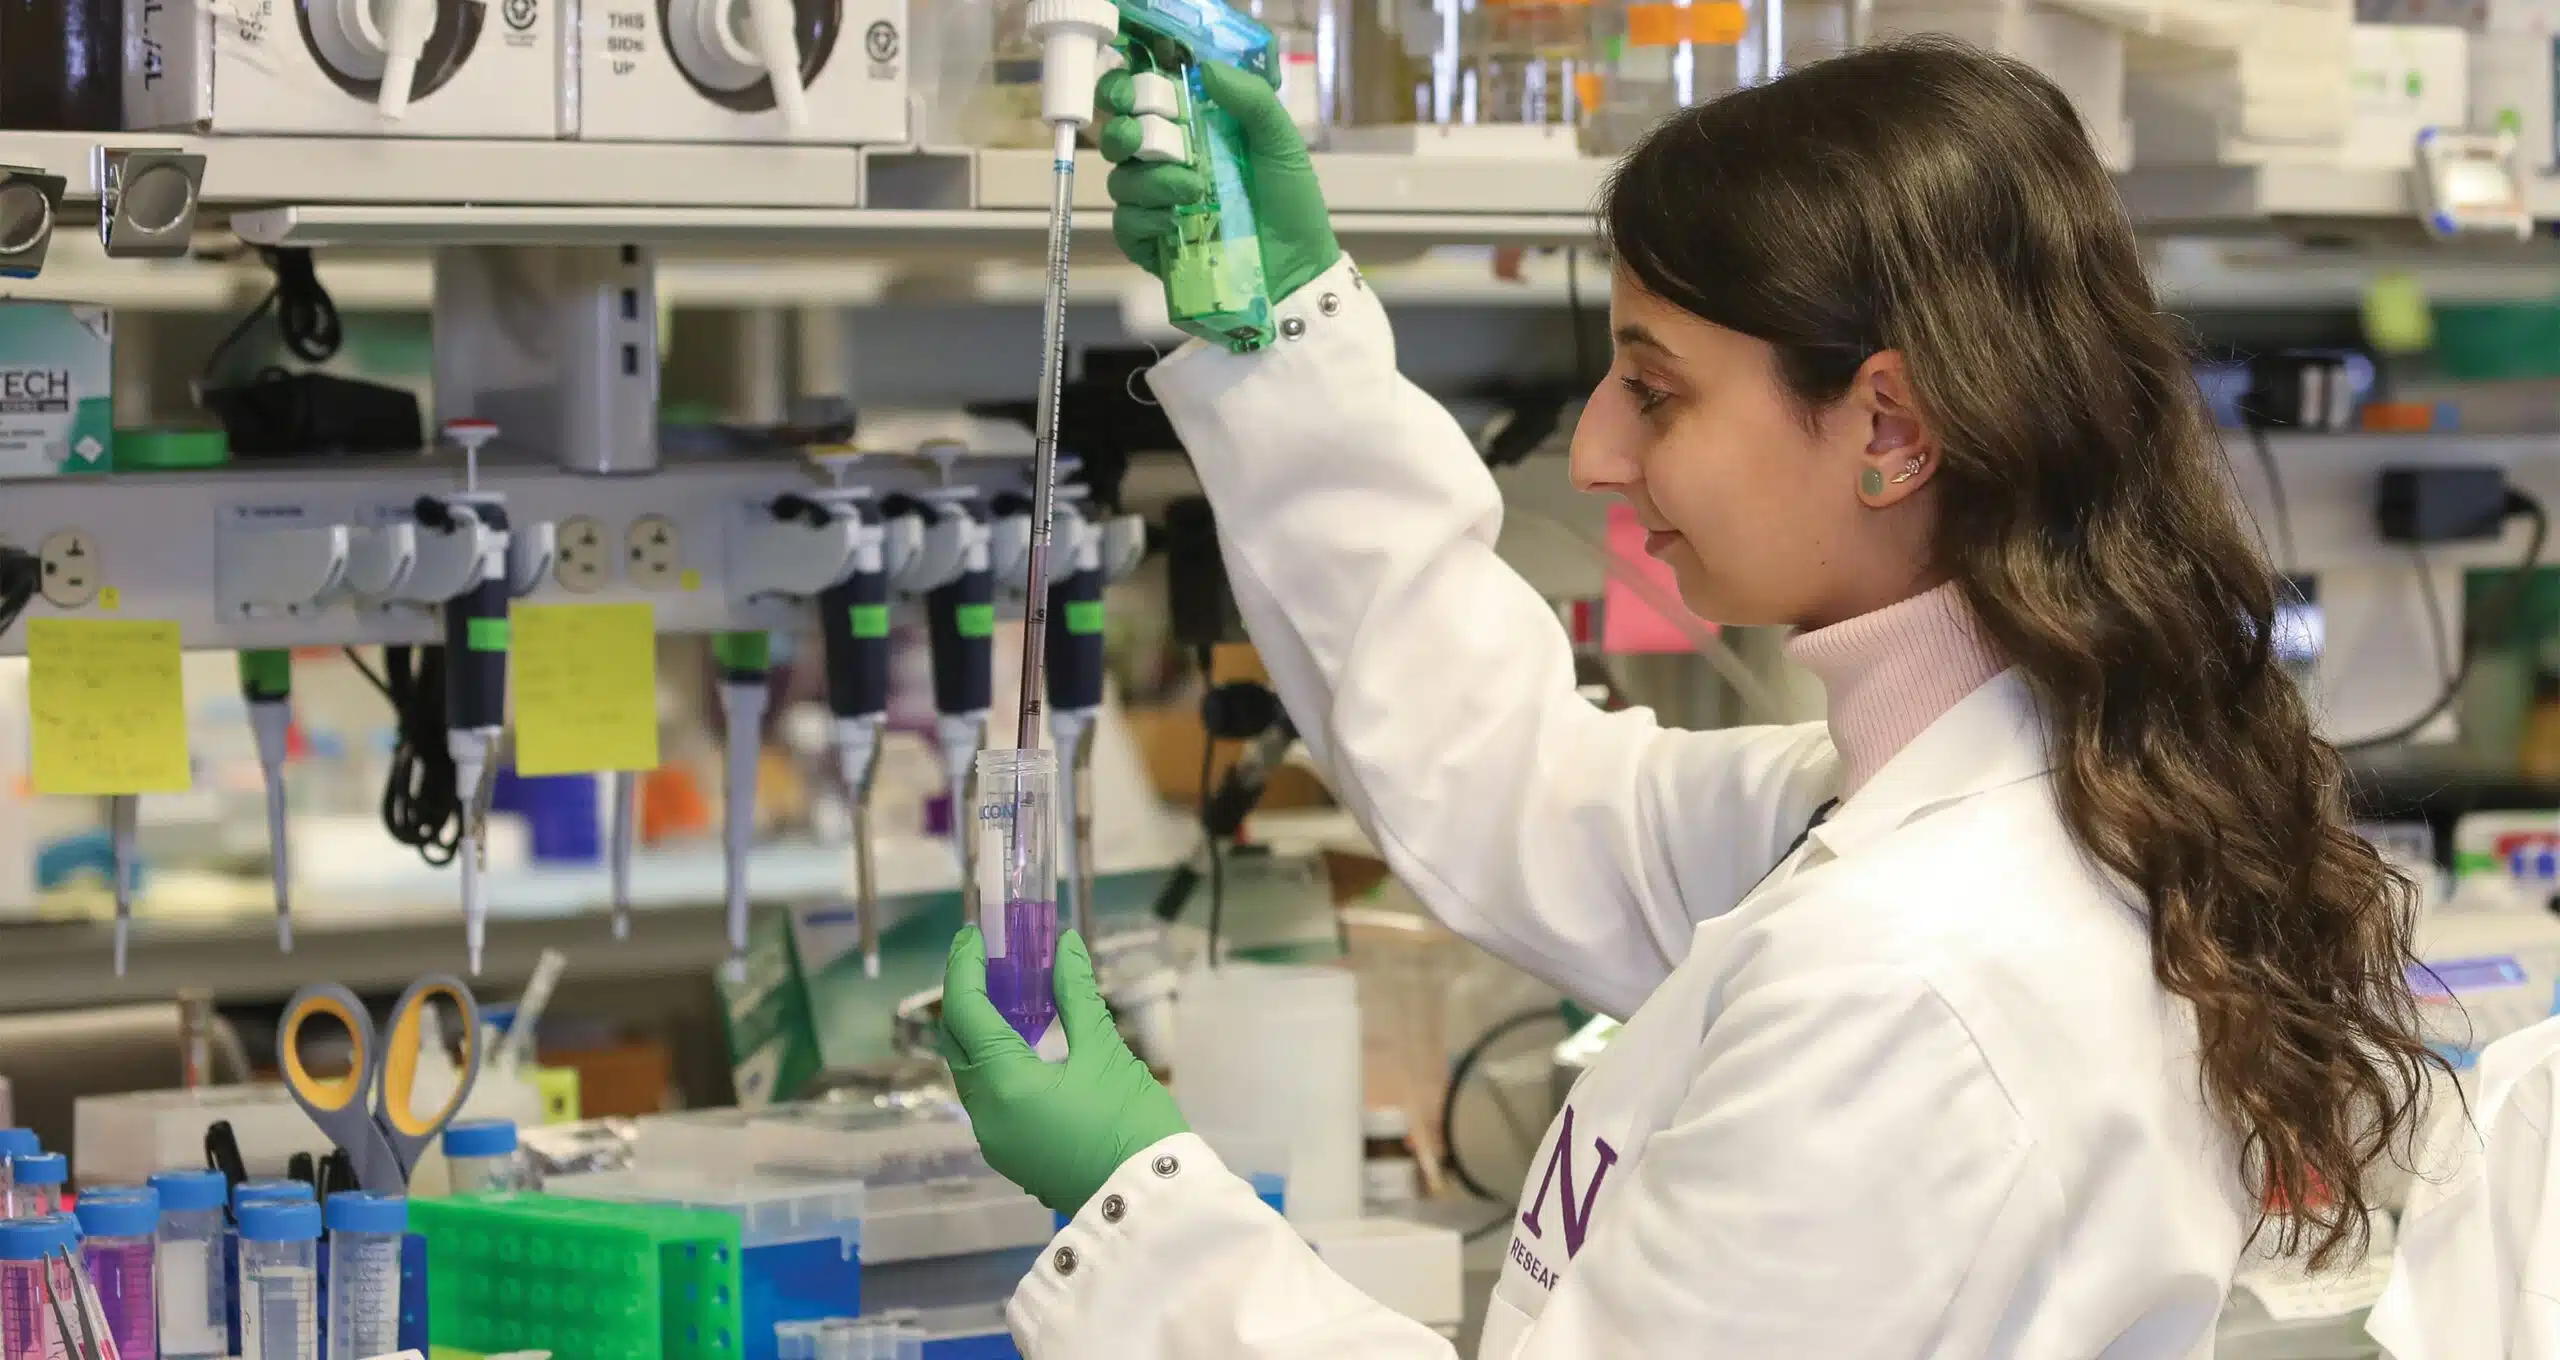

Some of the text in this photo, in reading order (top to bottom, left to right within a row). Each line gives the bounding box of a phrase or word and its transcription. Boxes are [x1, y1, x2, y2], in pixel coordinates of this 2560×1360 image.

[607, 12, 645, 31] THIS
[612, 60, 637, 76] UP
[1522, 1104, 1618, 1261] N
